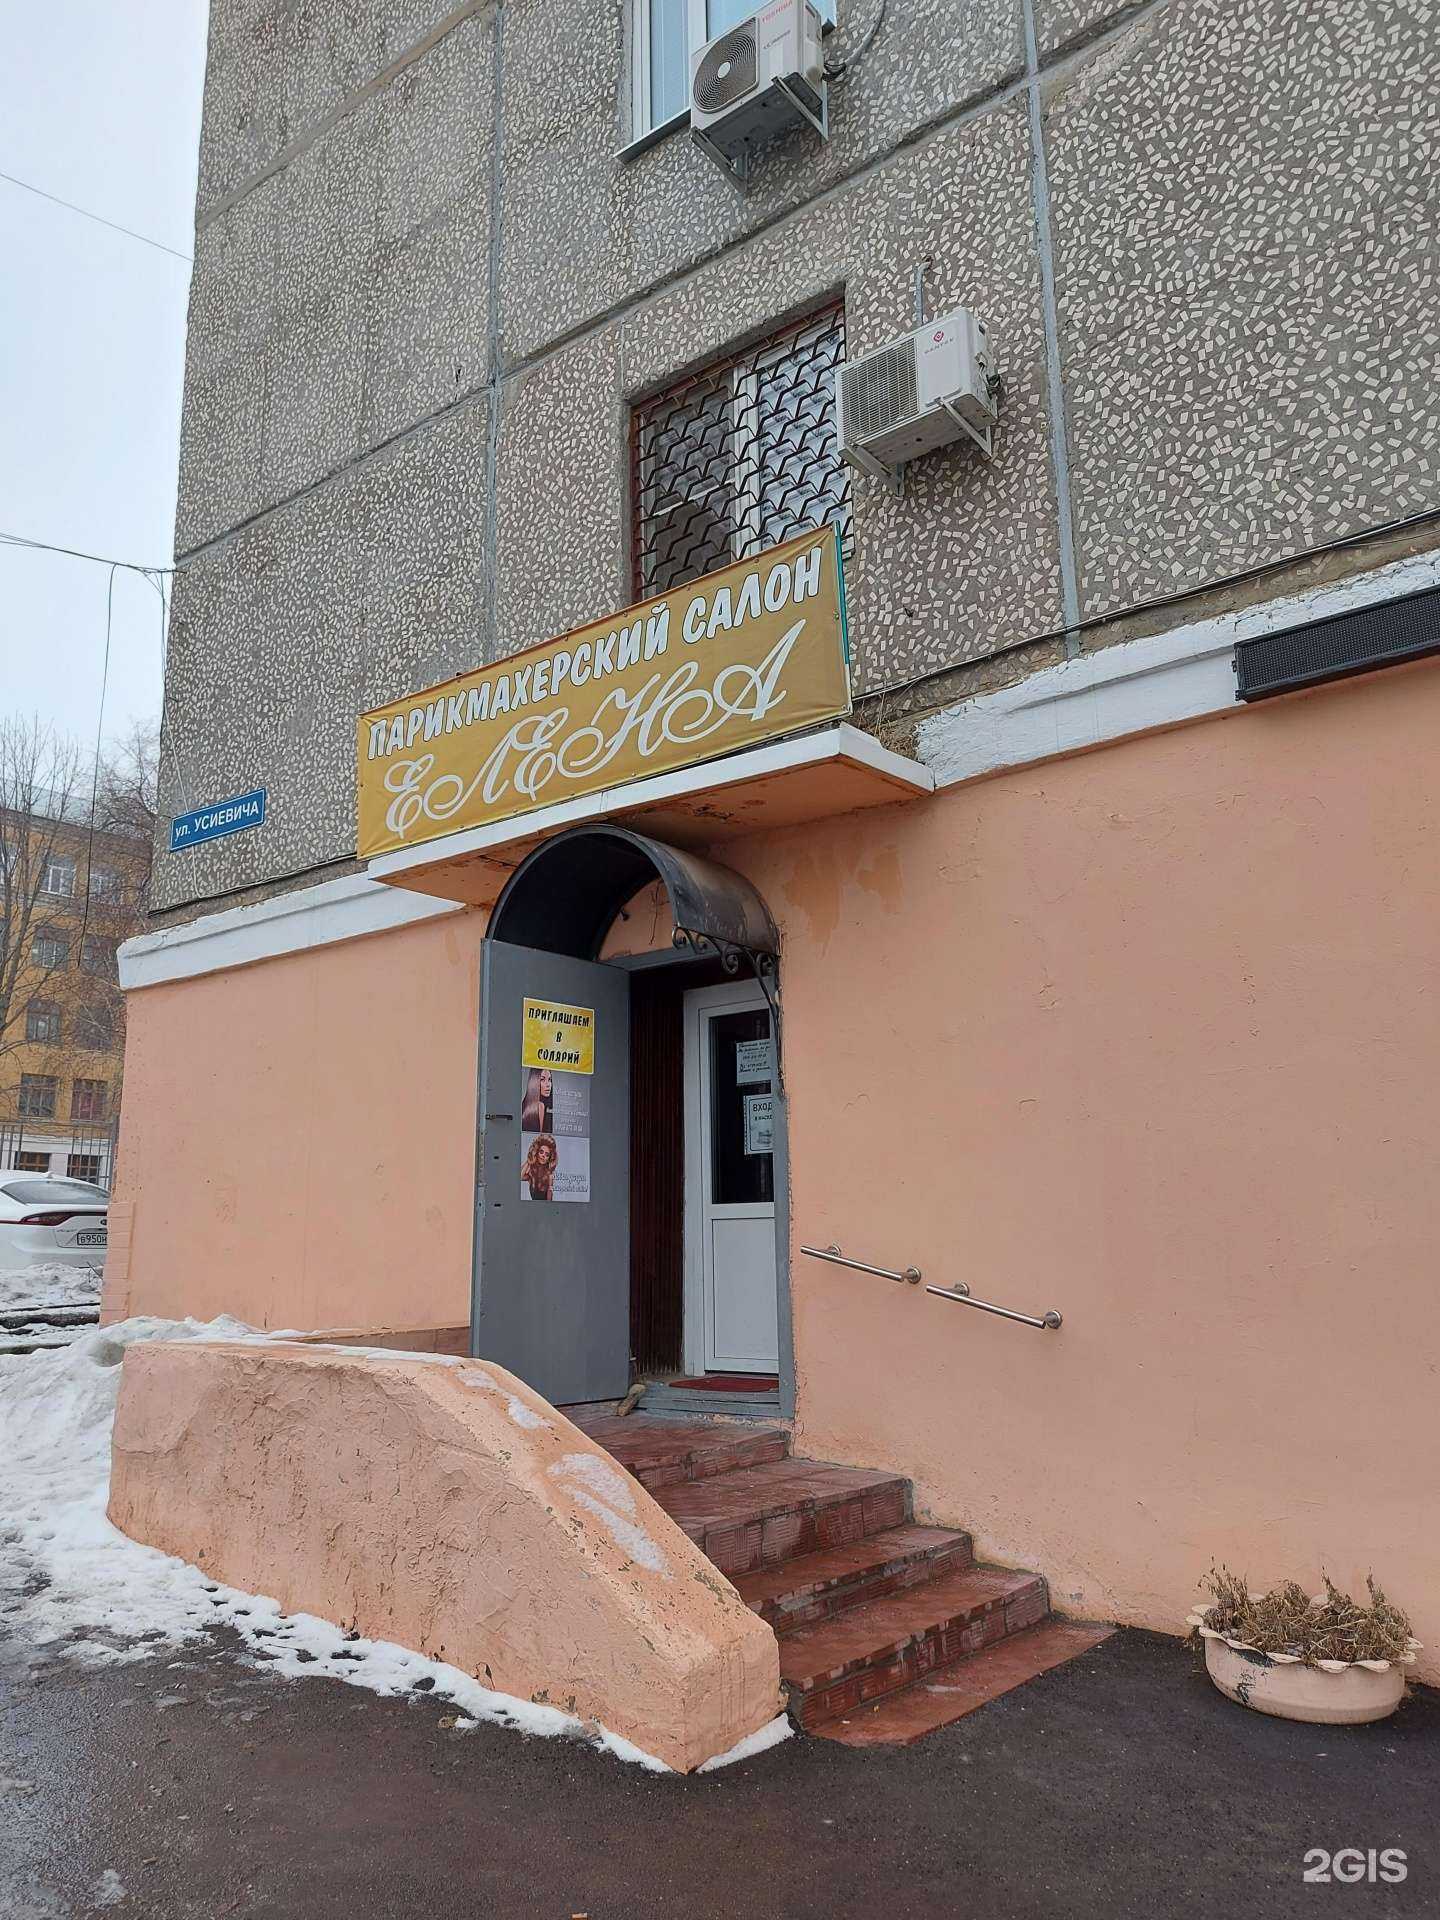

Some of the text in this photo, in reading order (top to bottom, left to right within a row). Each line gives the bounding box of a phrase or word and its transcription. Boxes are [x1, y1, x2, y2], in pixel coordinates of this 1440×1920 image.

[367, 546, 823, 761] ПАРИКМАХЕРСКИЙ САЛОН
[383, 618, 807, 839] ЕЛЕНА
[174, 801, 259, 842] ул. УСИЕВИЧА
[528, 1007, 590, 1028] ПРИГЛАШАЕМ
[537, 1048, 580, 1065] СОЛЯРИЙ
